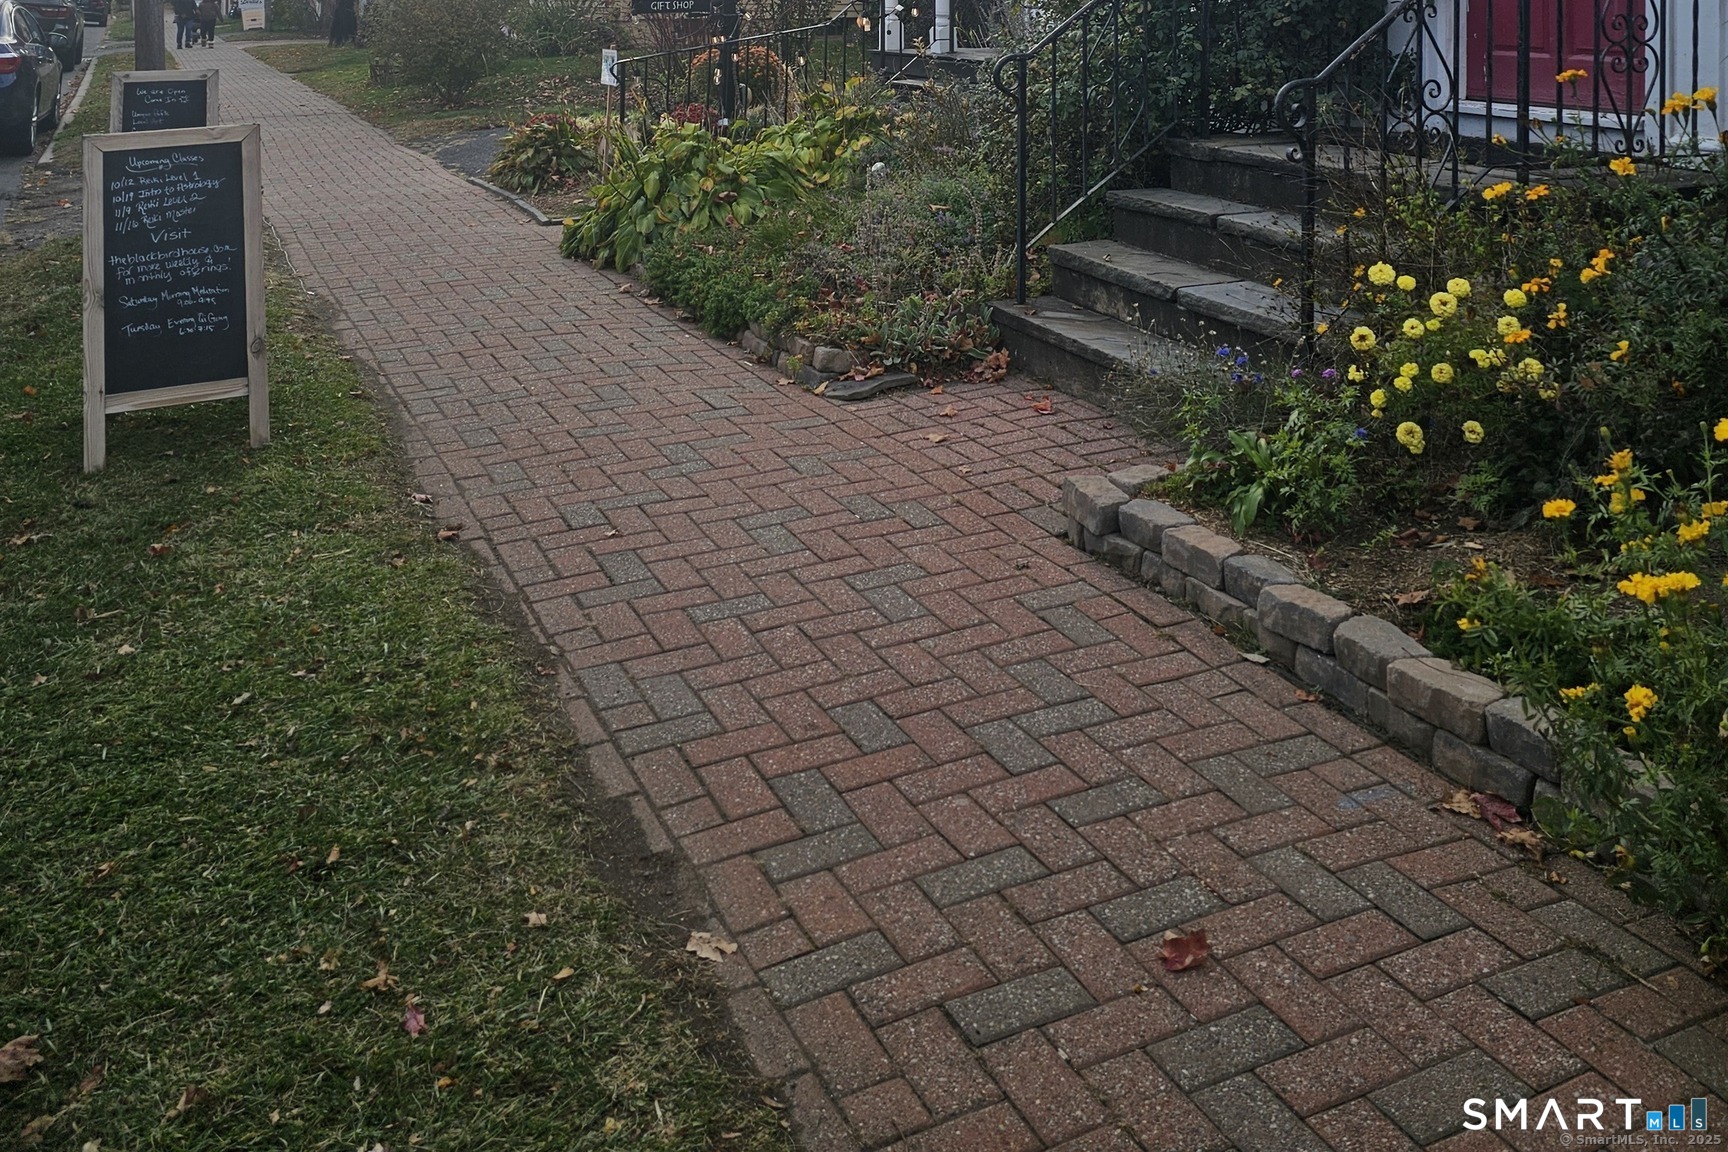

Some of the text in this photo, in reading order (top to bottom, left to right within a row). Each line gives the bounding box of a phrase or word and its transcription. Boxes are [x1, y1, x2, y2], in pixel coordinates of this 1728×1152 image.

[651, 1, 694, 10] GIFT SHOP
[129, 152, 204, 170] Upcoming Classes
[111, 177, 134, 190] 10/12
[165, 173, 188, 182] Level
[193, 171, 200, 180] 1
[112, 177, 226, 203] 10/19 Intro to Astrology
[115, 206, 131, 218] 11/9
[163, 195, 187, 207] Level
[189, 192, 207, 201] 2
[151, 227, 192, 243] Visit
[116, 266, 134, 280] for
[137, 263, 160, 273] more
[165, 257, 199, 269] weekly
[119, 296, 158, 310] Saturday
[122, 323, 162, 336] Tuesday
